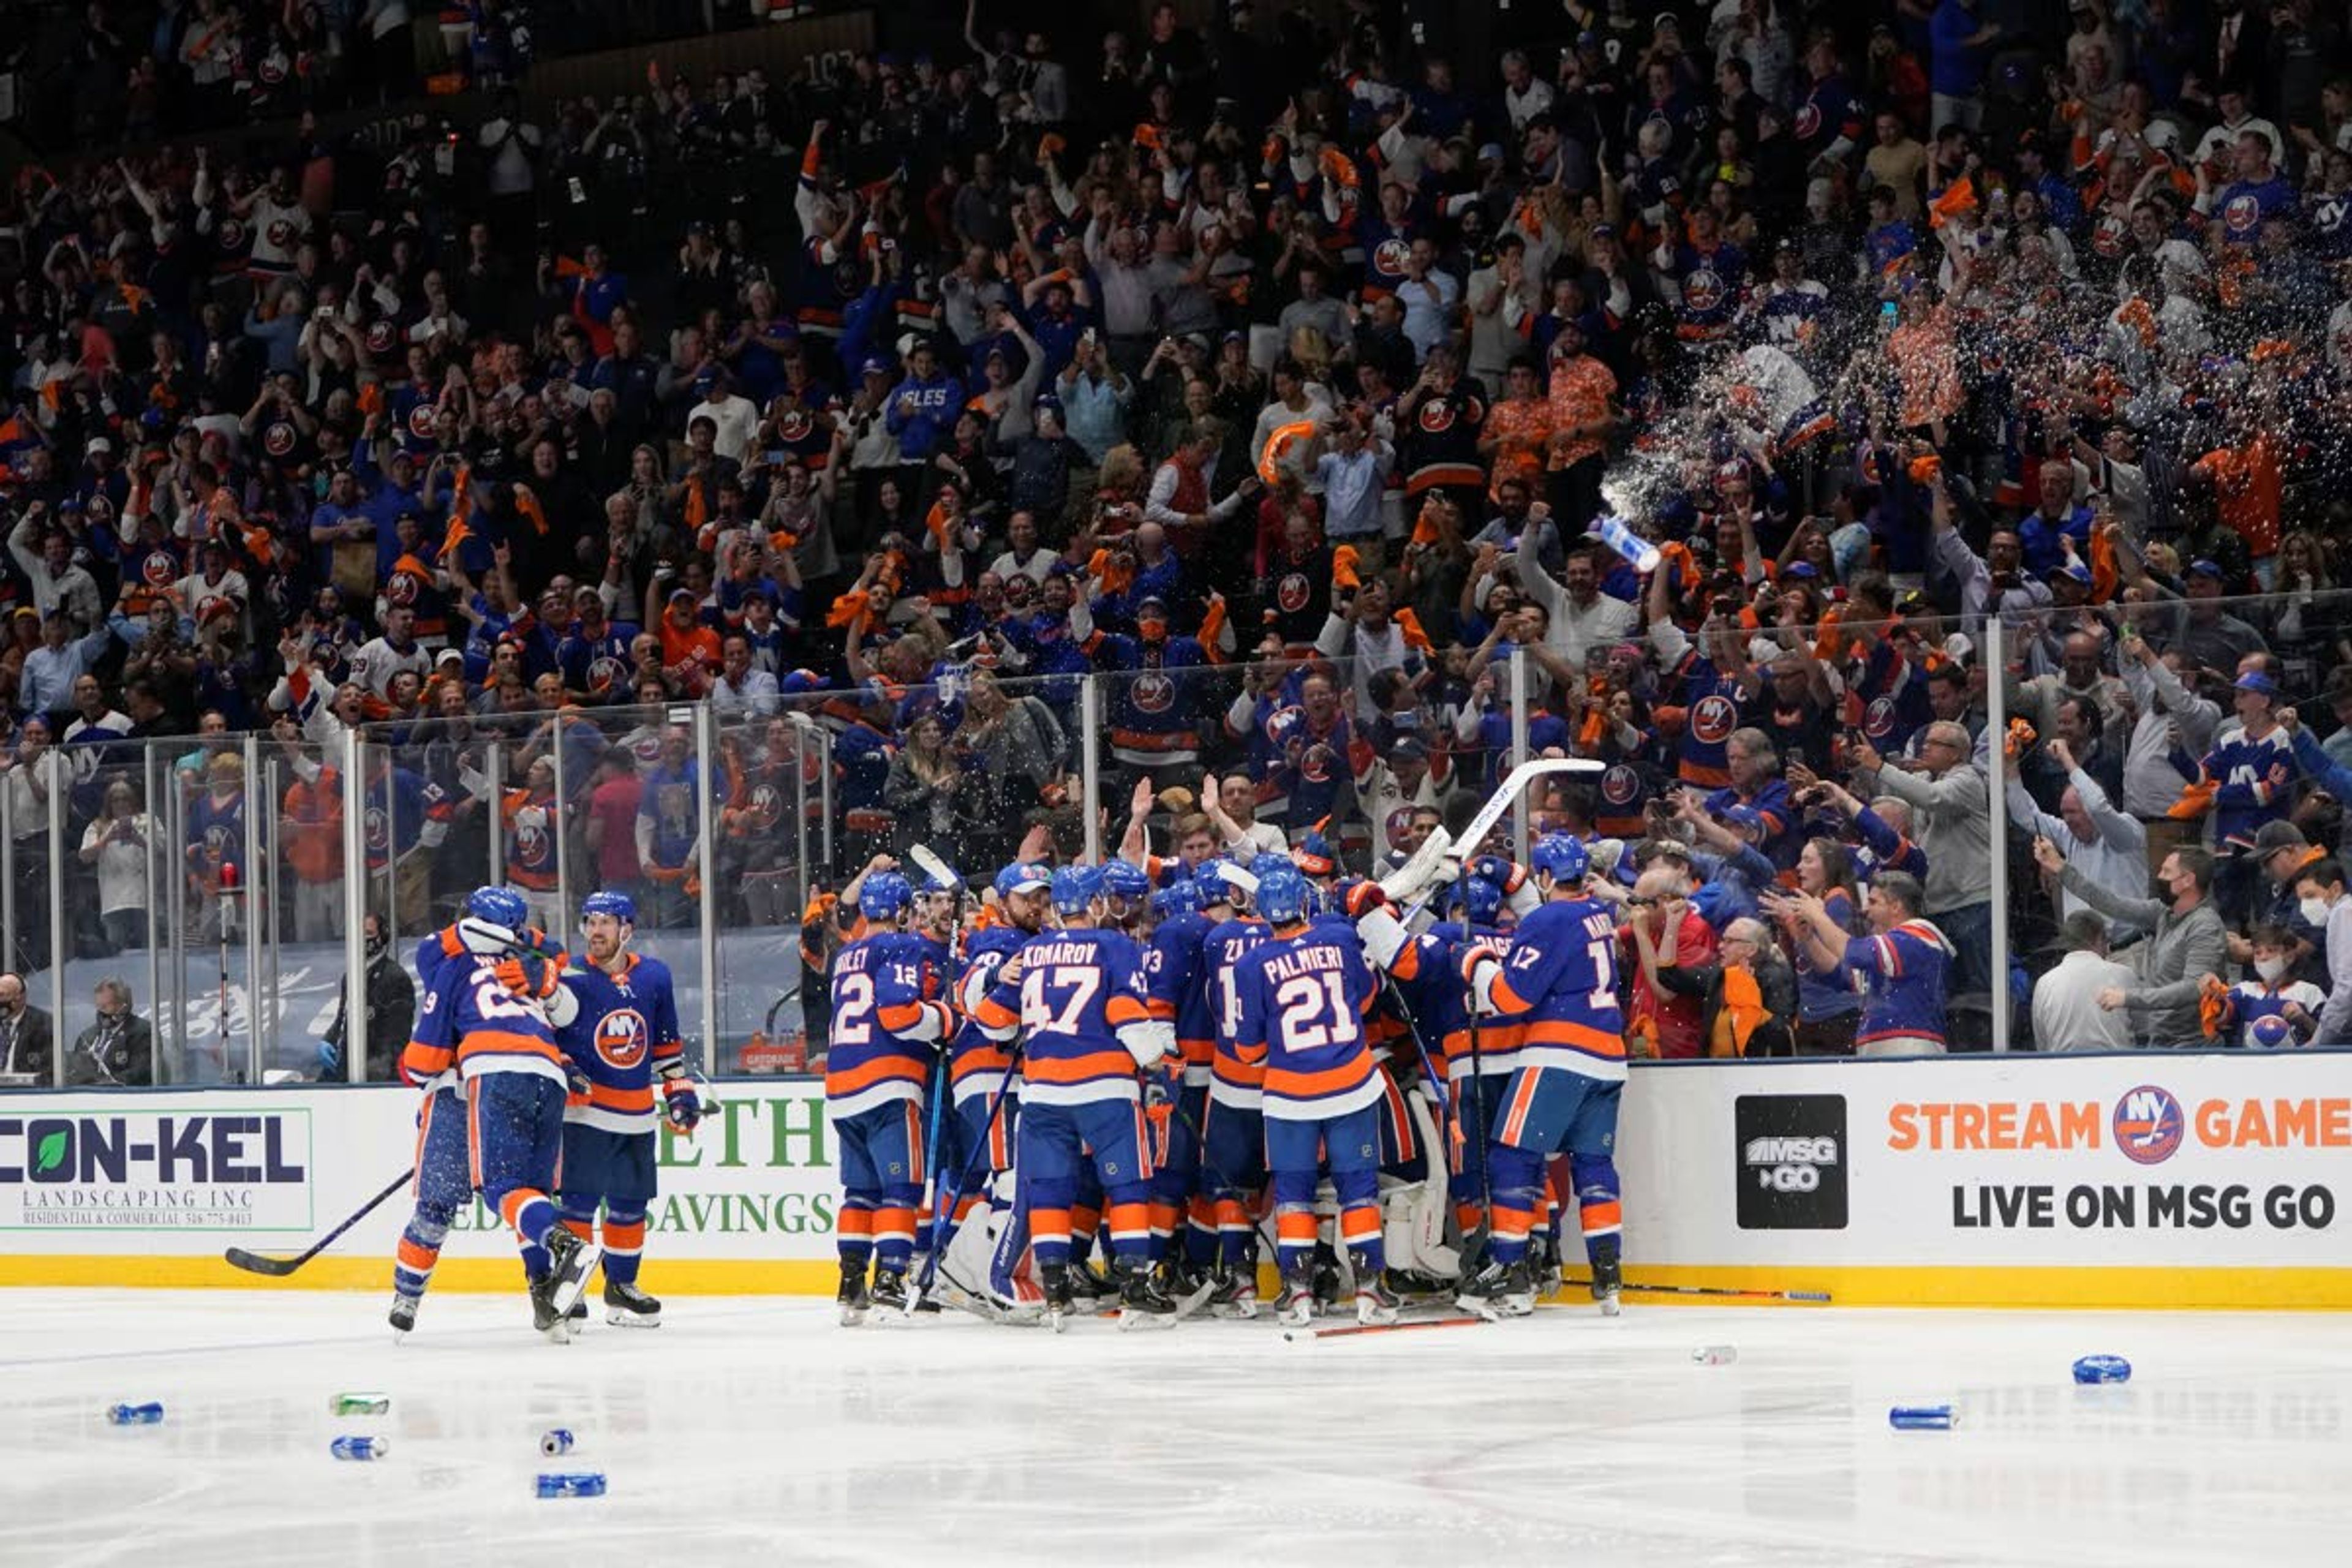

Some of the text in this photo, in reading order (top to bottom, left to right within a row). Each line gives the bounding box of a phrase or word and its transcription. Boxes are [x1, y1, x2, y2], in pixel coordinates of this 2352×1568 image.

[1022, 943, 1096, 968] KOMAROV
[1264, 946, 1344, 984] PALMIERI
[1512, 946, 1542, 969] 17
[894, 963, 918, 987] 12
[1588, 939, 1619, 1009] 1
[1020, 966, 1101, 1041] 47
[1276, 971, 1357, 1053] 21
[1888, 1102, 2101, 1150] STREAM
[2195, 1099, 2352, 1148] GAME
[1759, 1137, 1837, 1164] MSG
[1773, 1165, 1820, 1192] GO
[23, 1190, 252, 1207] LANDSCAPING INC
[1953, 1185, 2335, 1229] LIVE ON MSG GO
